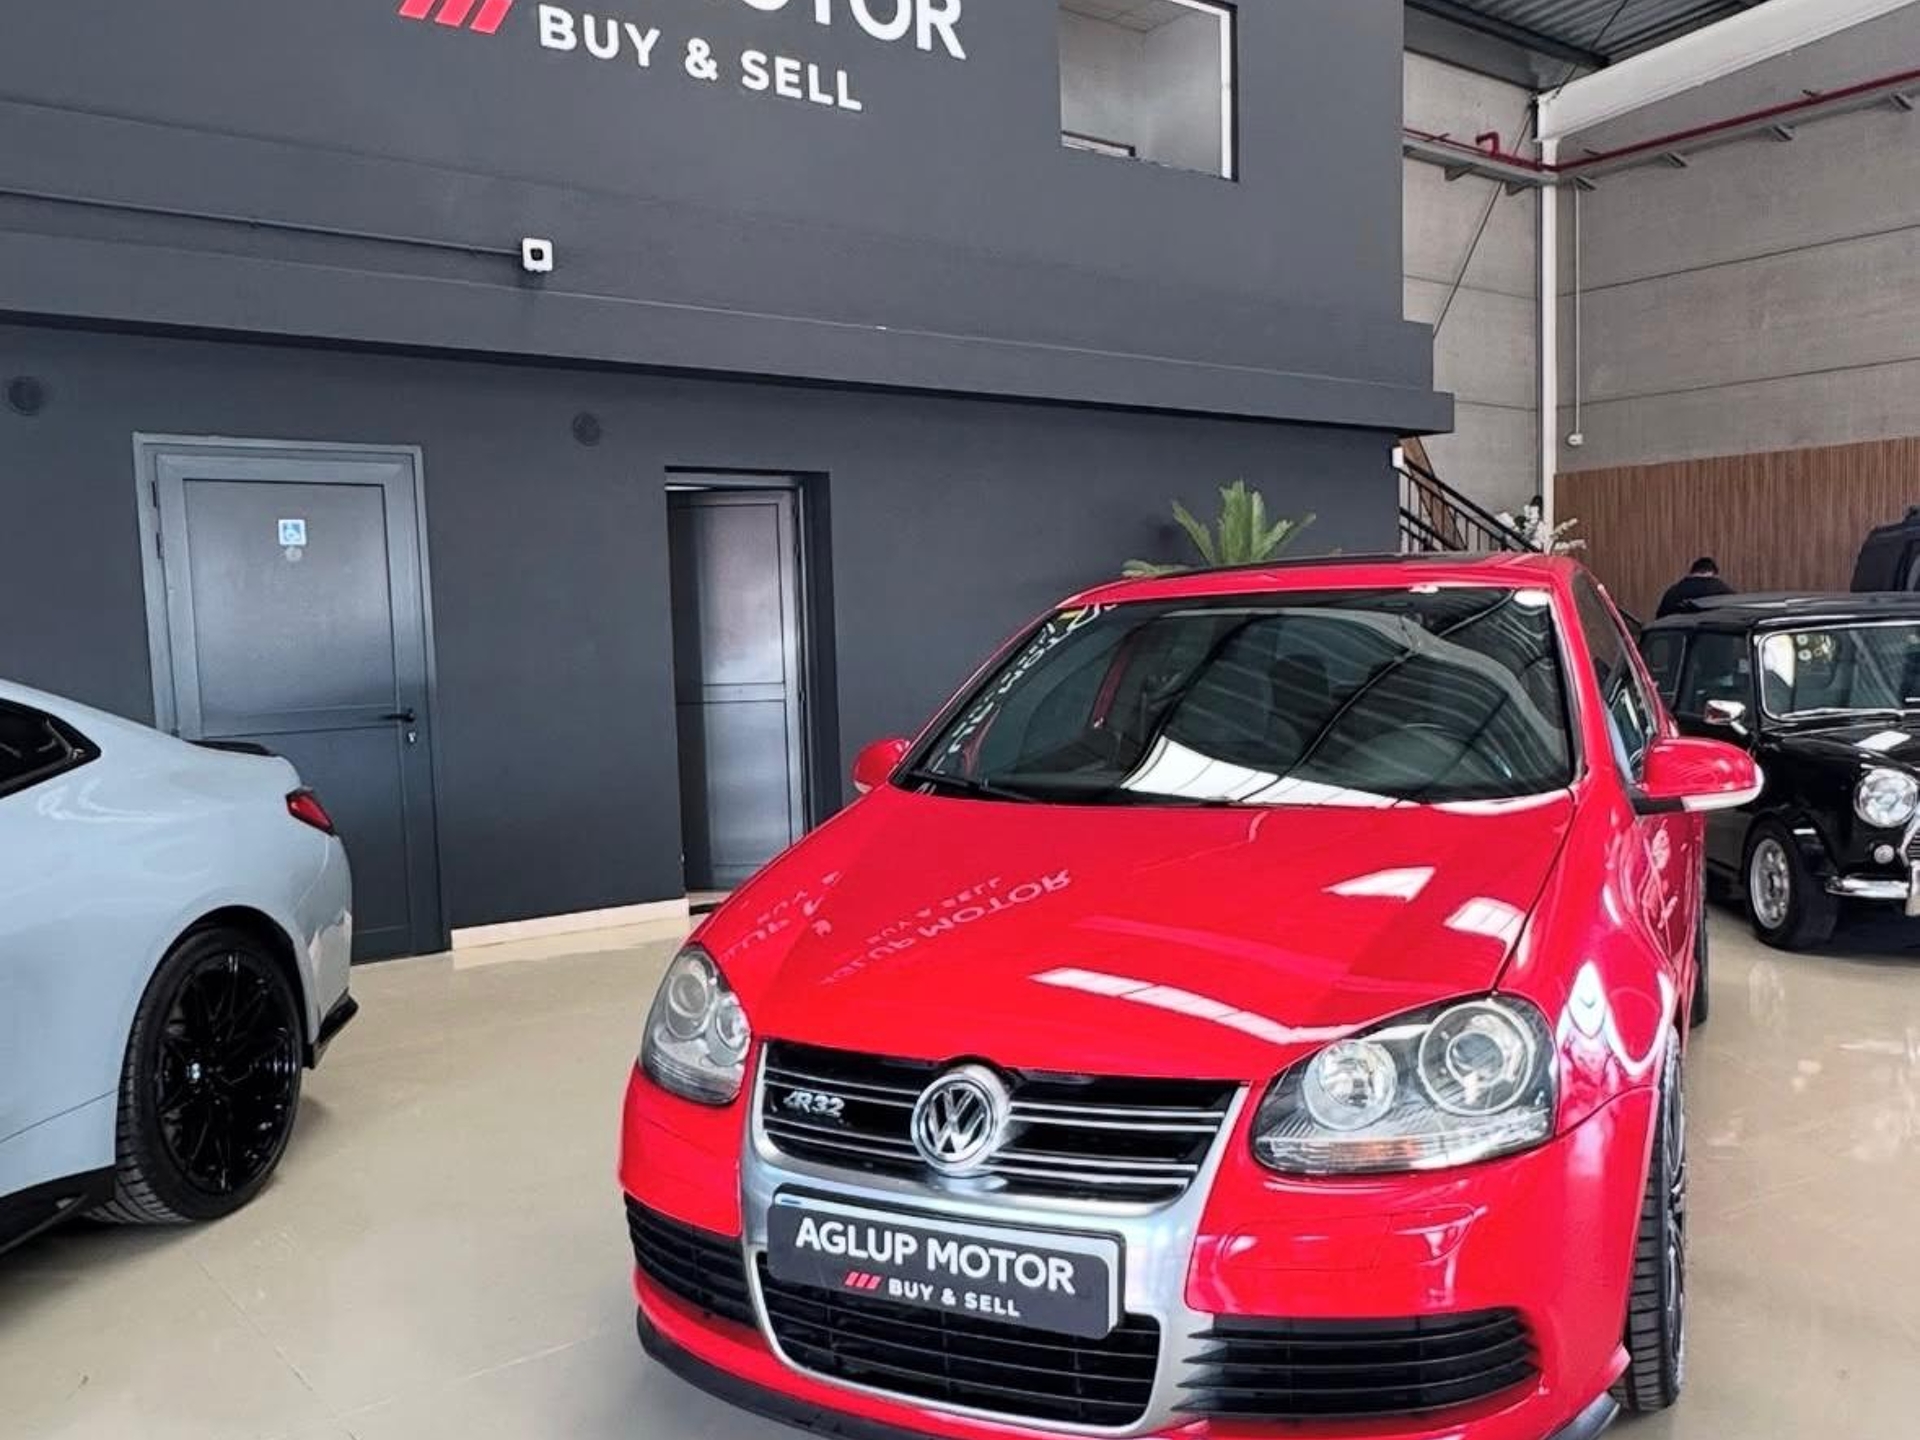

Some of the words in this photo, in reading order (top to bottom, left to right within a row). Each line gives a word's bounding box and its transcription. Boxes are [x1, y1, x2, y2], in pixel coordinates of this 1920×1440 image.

[538, 4, 660, 66] BUY
[684, 38, 718, 81] &
[740, 49, 863, 111] SELL
[785, 1090, 845, 1118] R32
[795, 1217, 919, 1265] AGLUP
[926, 1237, 1076, 1294] MOTOR
[888, 1278, 934, 1301] BUY
[940, 1287, 957, 1306] &
[964, 1292, 1020, 1318] SELL
